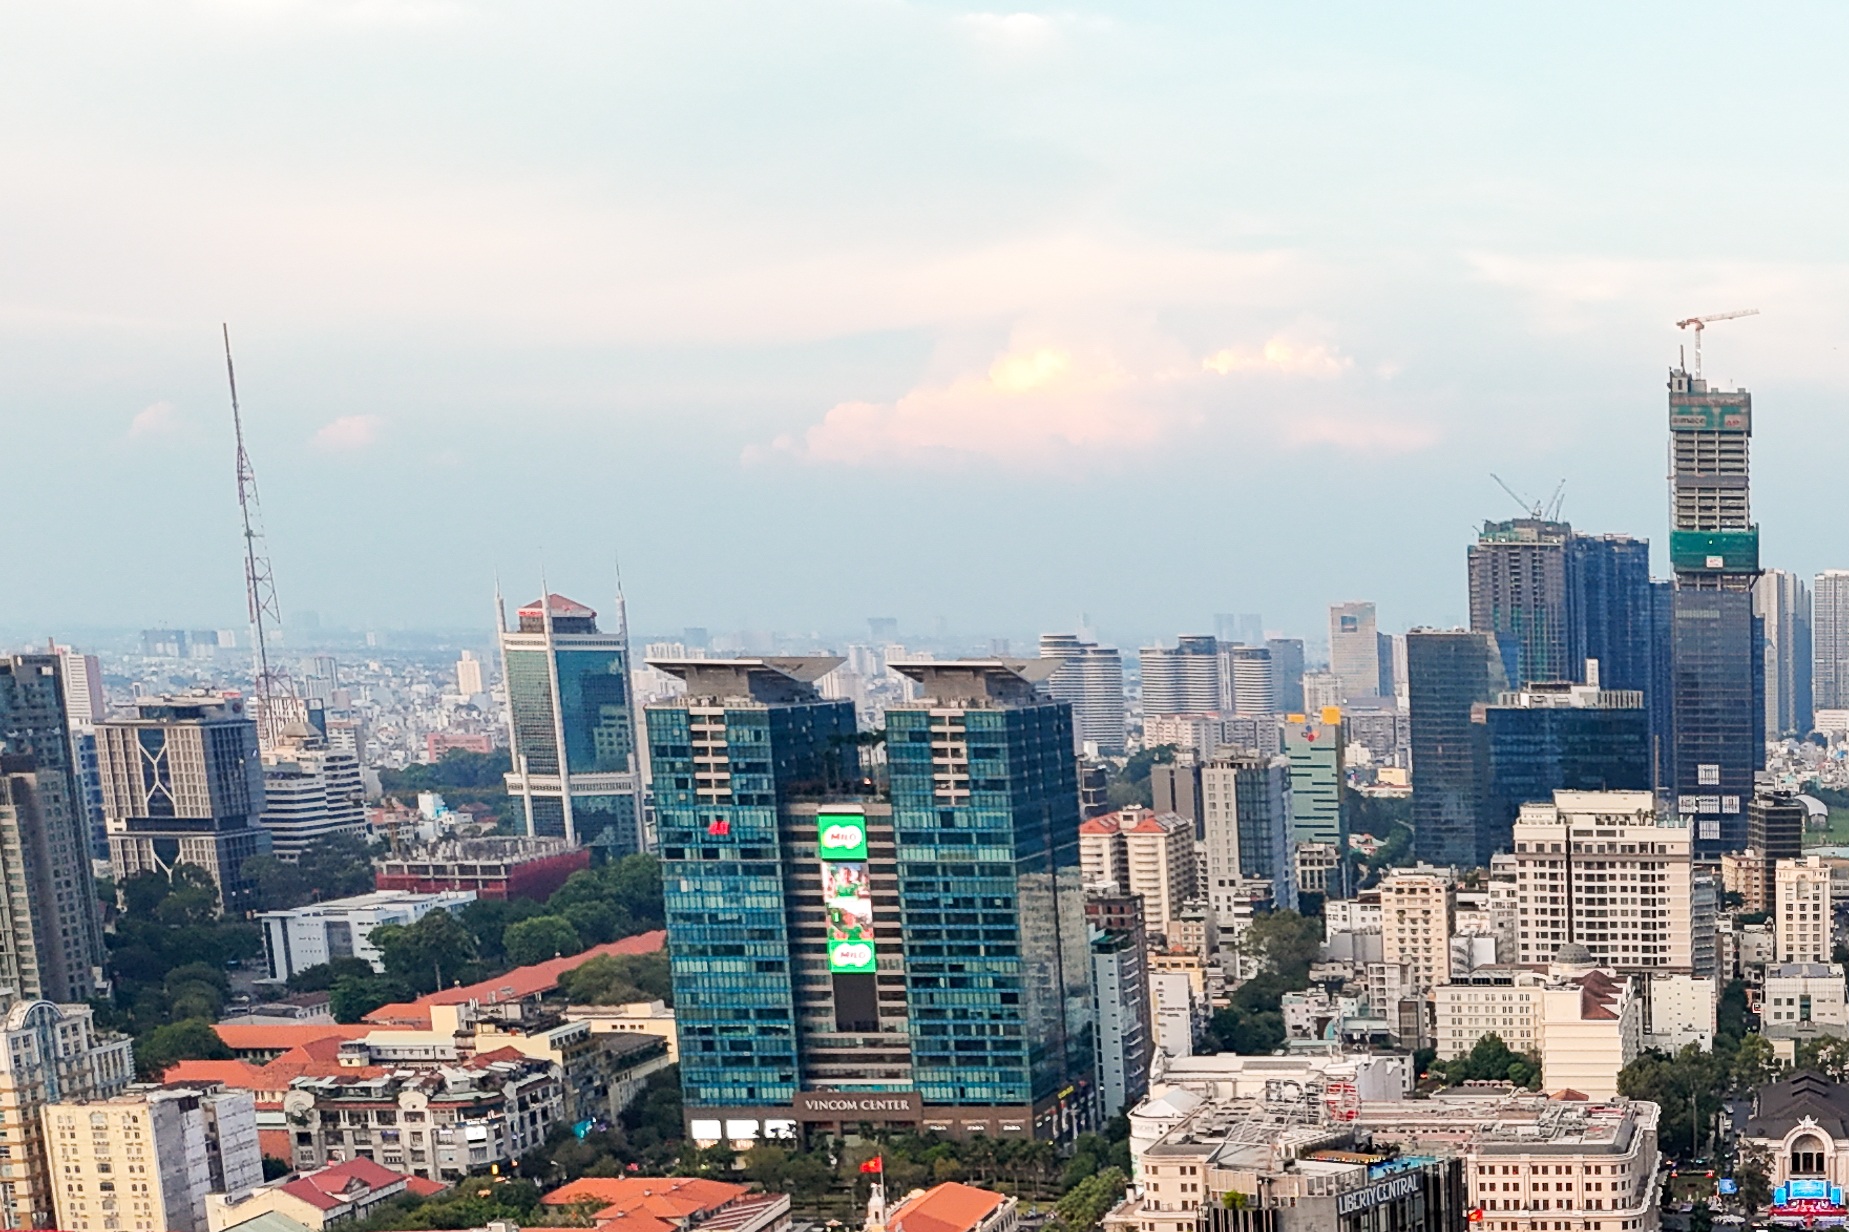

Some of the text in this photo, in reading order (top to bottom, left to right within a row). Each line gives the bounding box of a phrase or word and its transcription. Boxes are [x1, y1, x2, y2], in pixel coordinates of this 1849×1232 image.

[831, 833, 857, 841] MILO
[805, 1100, 910, 1110] VINCOM CENTER
[1338, 1174, 1419, 1215] LIBERTY CENTRAL
